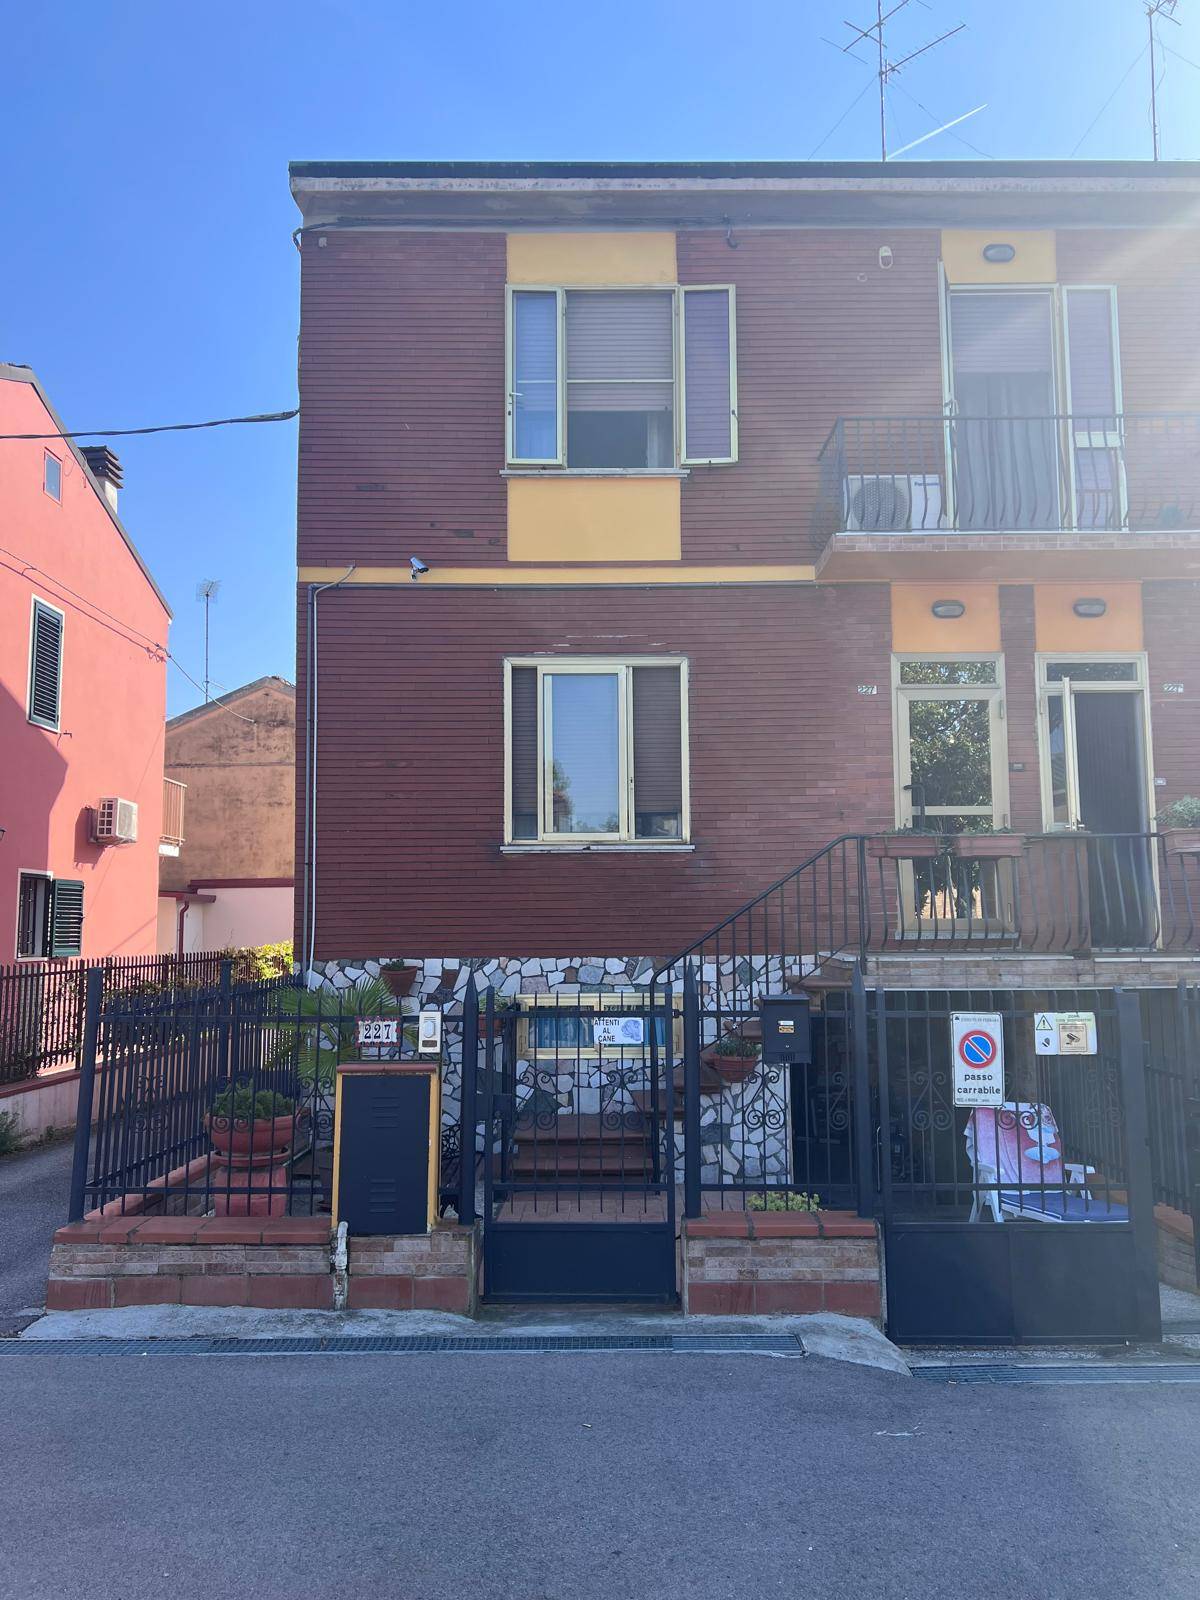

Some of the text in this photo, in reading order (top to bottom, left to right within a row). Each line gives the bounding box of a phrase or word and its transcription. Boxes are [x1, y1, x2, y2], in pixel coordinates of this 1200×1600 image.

[594, 1018, 620, 1026] ATTENTI
[364, 1024, 391, 1040] 227
[964, 1074, 993, 1082] passo
[957, 1086, 1001, 1095] carrabile
